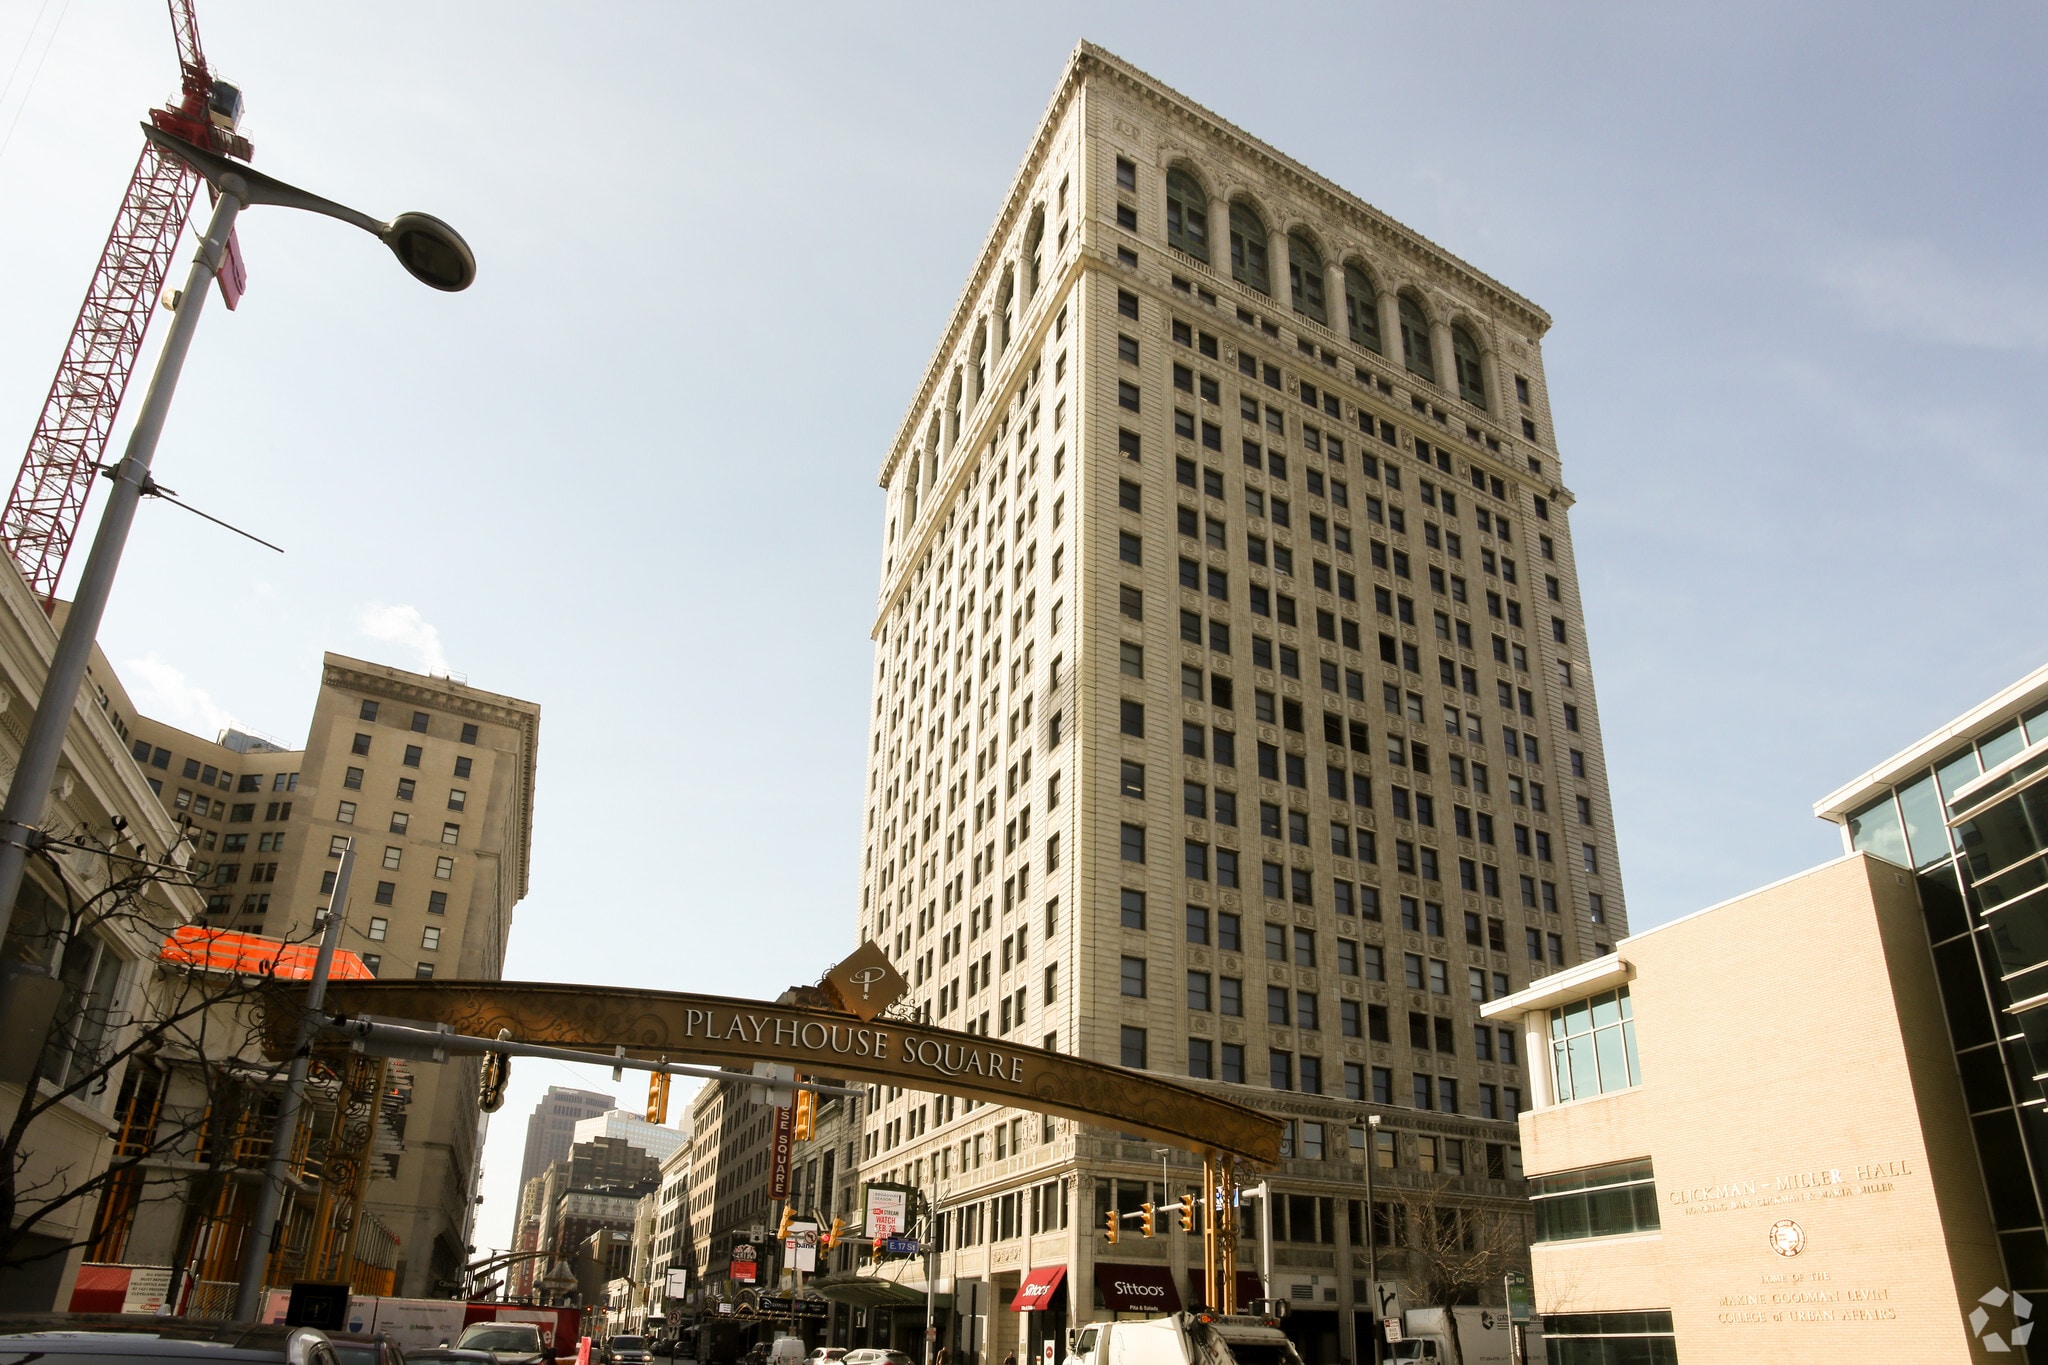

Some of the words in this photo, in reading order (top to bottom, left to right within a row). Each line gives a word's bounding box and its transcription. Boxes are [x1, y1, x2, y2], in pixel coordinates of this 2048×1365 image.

[685, 1008, 889, 1059] PLAYHOUSE
[902, 1036, 1024, 1083] SQUARE
[775, 1135, 788, 1193] SQUARE
[1669, 1180, 1757, 1206] GLICKMAN
[1776, 1168, 1845, 1191] MILLER
[1856, 1160, 1912, 1182] HALL
[1857, 1182, 1896, 1195] MILLER
[876, 1216, 896, 1224] WATCH
[888, 1225, 896, 1233] 26
[906, 1243, 916, 1251] St
[1760, 1273, 1788, 1284] HOME
[1792, 1273, 1804, 1282] OF
[1808, 1271, 1831, 1281] THE
[1114, 1281, 1165, 1297] Sittoo's
[1719, 1294, 1767, 1307] MAXINE
[1772, 1291, 1840, 1305] GOODMAN
[1847, 1288, 1889, 1301] LEVIN
[1718, 1310, 1767, 1324] COLLEGE
[1773, 1311, 1783, 1322] of
[1788, 1309, 1836, 1322] URBAN
[1842, 1308, 1897, 1321] AFFAIRS
